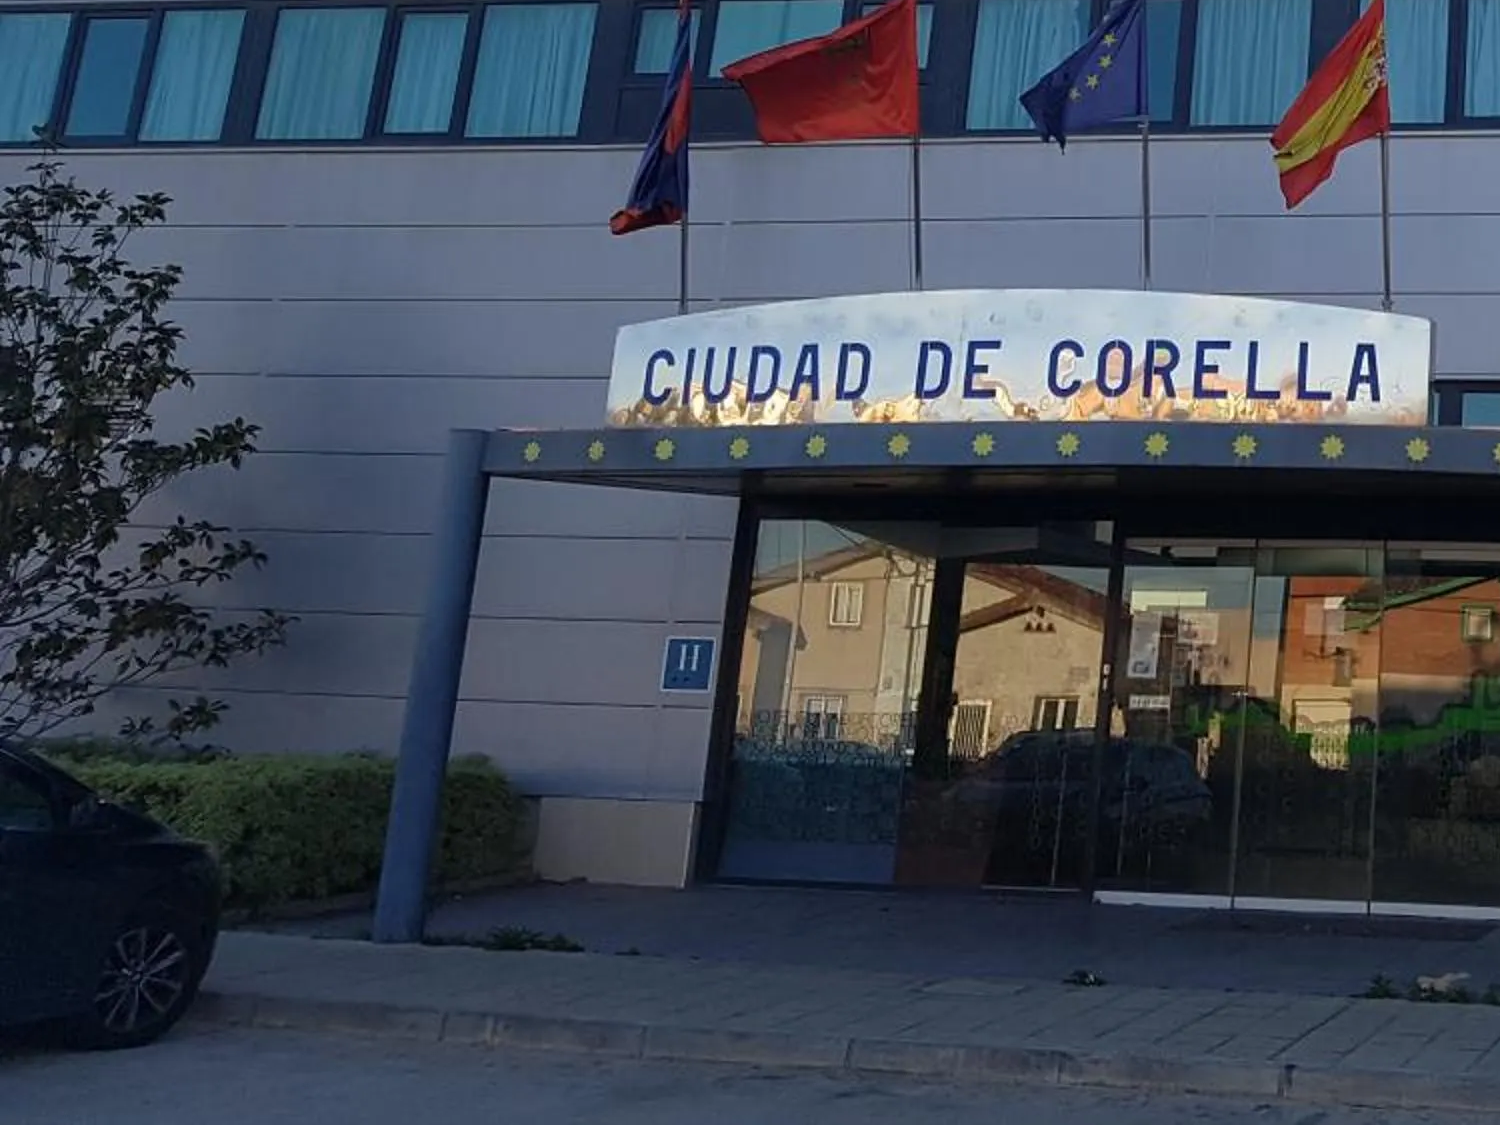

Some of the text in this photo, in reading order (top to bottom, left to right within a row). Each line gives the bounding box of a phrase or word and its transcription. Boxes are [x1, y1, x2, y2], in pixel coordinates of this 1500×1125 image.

[642, 339, 1382, 406] CIUDAD DE CORELLA
[679, 643, 701, 672] H
